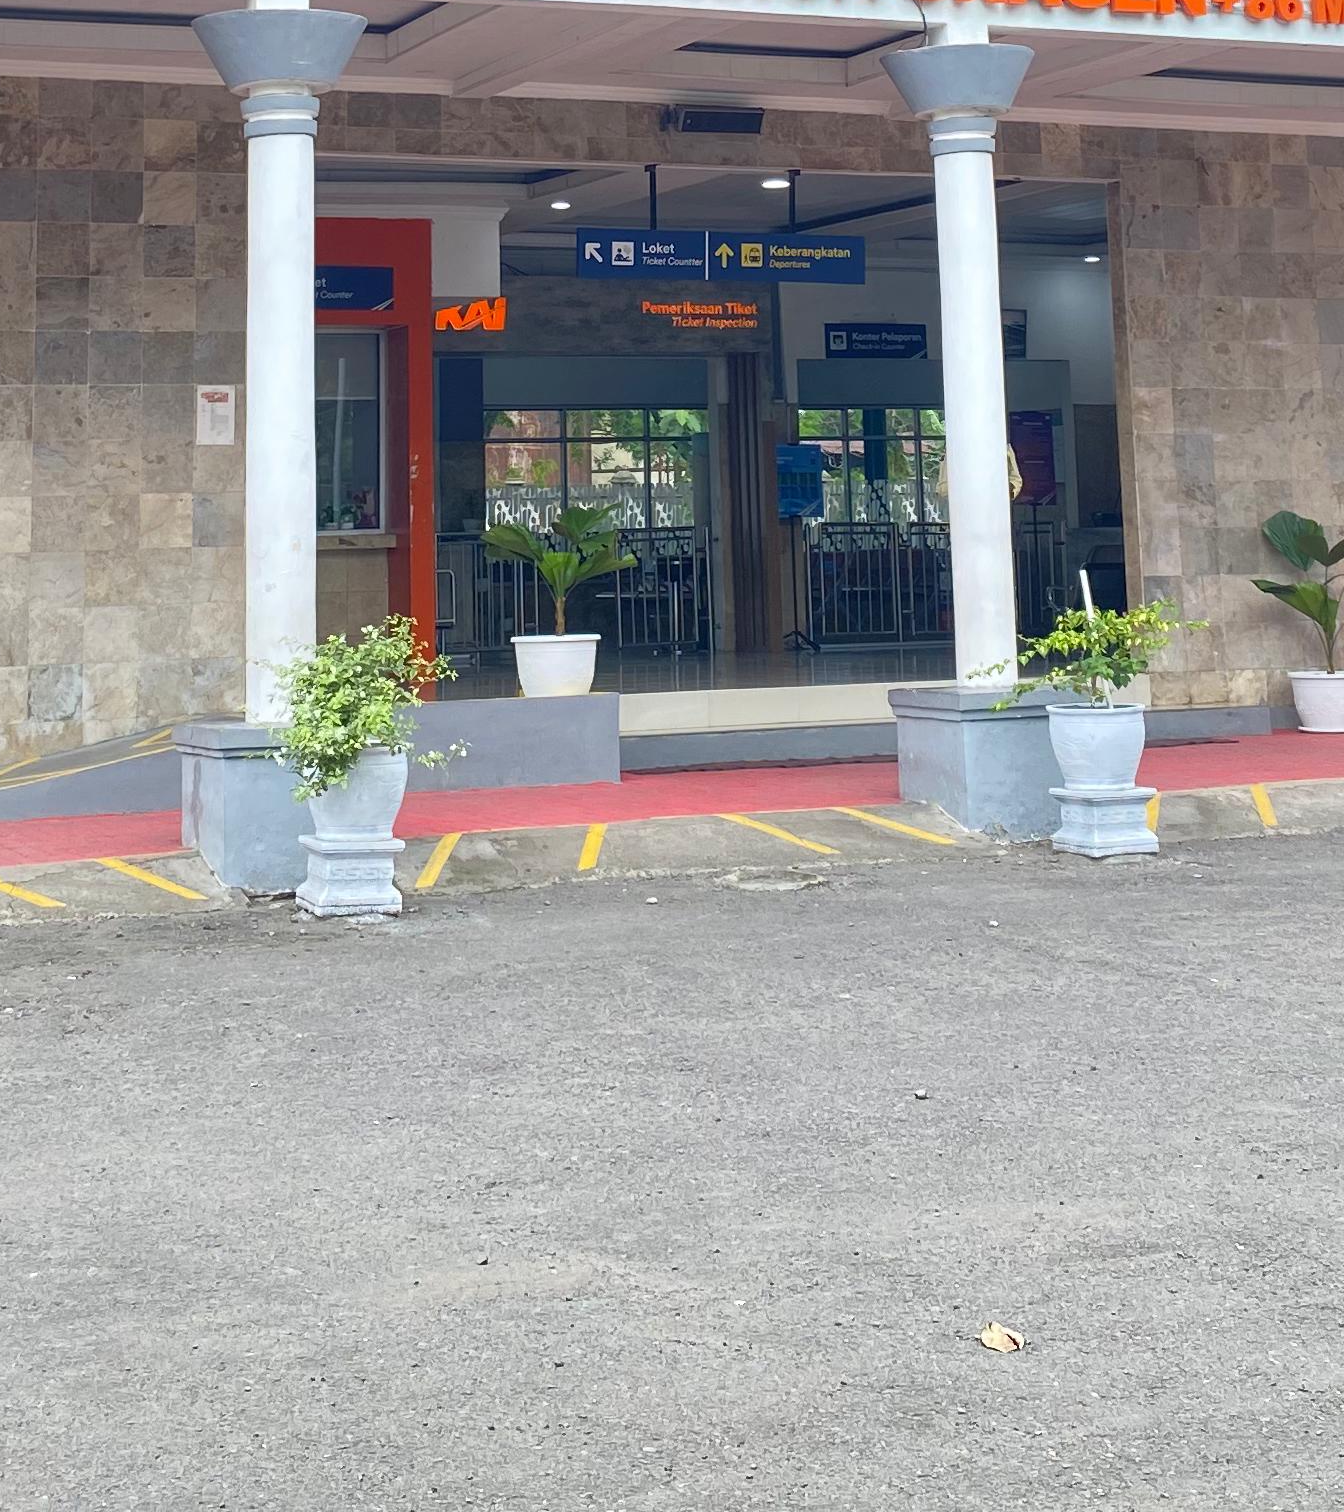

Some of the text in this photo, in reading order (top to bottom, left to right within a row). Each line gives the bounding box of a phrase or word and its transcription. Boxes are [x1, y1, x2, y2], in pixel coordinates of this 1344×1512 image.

[642, 242, 675, 254] Loket
[769, 245, 851, 259] Keberangkatan
[642, 256, 666, 265] Ticket
[769, 259, 811, 269] Departures
[319, 289, 354, 299] Counter
[642, 300, 758, 315] Pemeriksaan Tiket
[435, 297, 507, 331] KAI
[672, 316, 758, 329] Ticket Inspection
